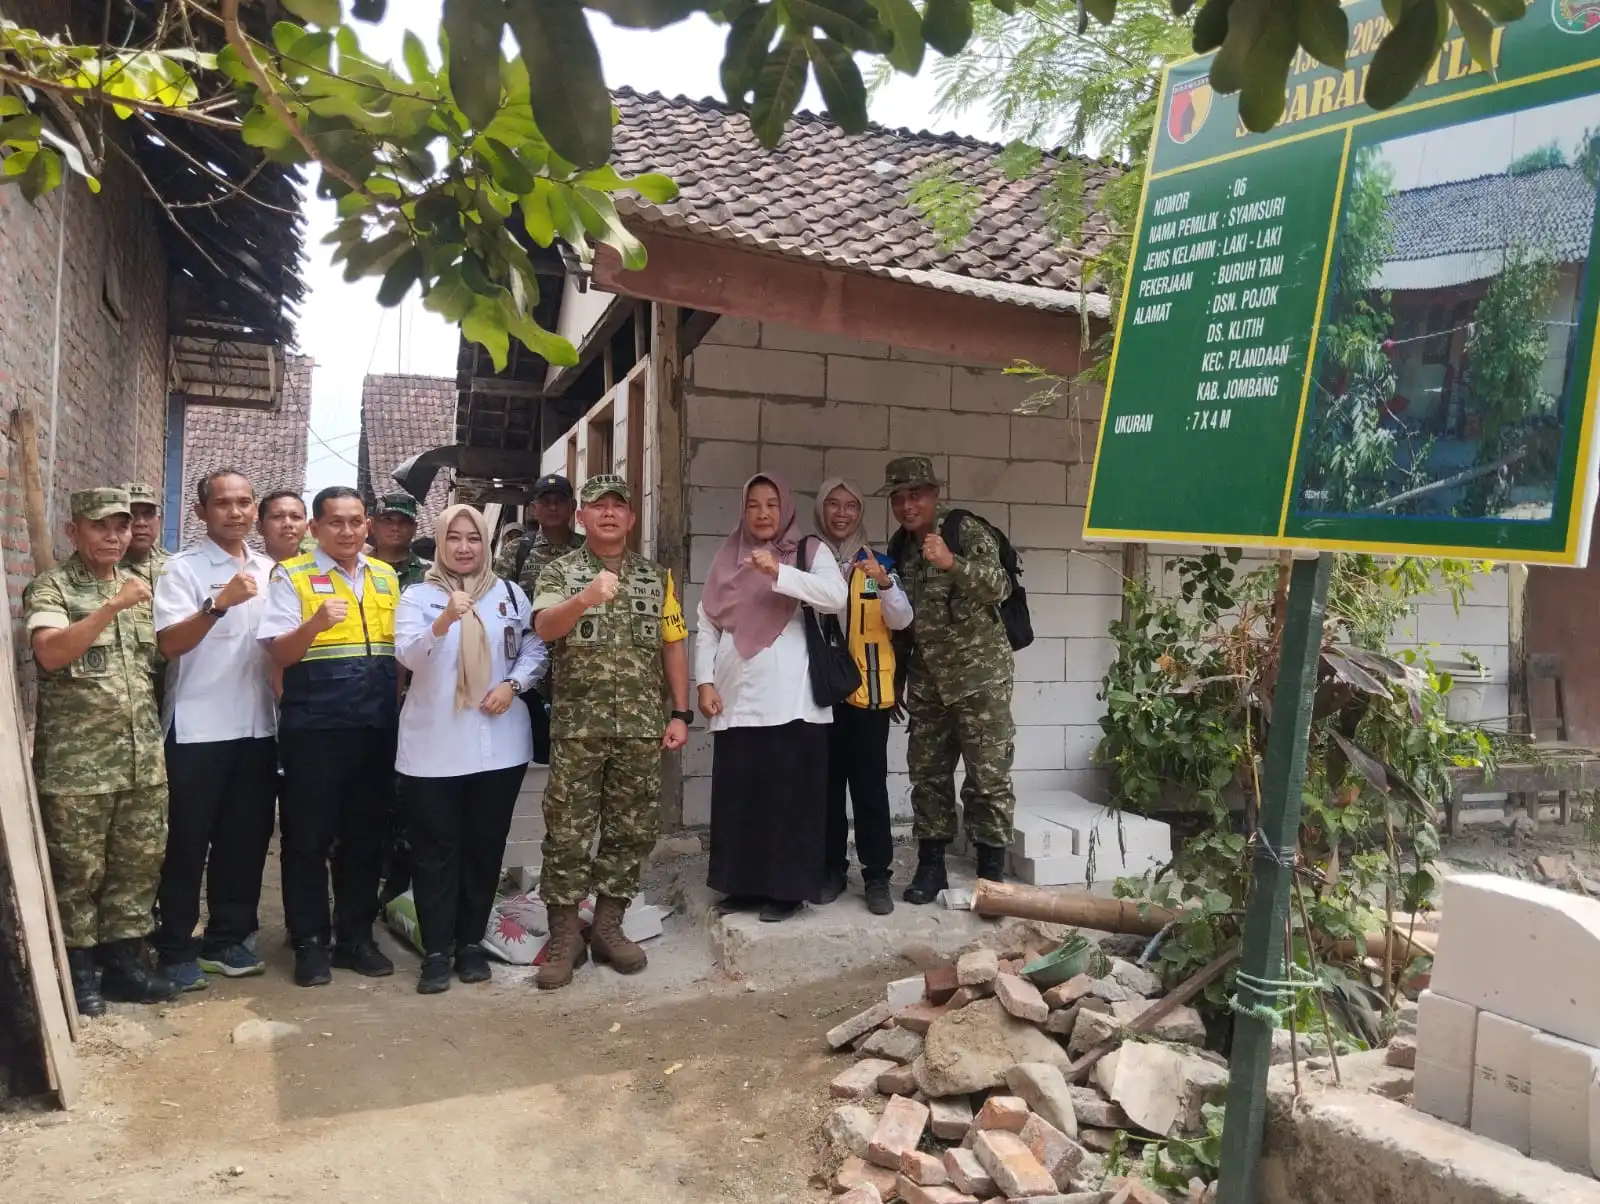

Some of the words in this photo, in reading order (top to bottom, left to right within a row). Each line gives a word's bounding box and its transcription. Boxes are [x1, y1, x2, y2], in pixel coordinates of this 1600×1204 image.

[1153, 191, 1190, 217] NOMOR
[1233, 177, 1248, 199] 06
[1148, 223, 1176, 244] NAMA
[1177, 211, 1219, 238] PEMILIK
[1228, 196, 1286, 227] SYAMSURI
[1143, 249, 1171, 272] JENIS
[1171, 239, 1217, 266] KELAMIN
[1222, 232, 1248, 256] LAKI
[1256, 225, 1283, 249] LAKI
[1138, 271, 1194, 298] PEKERJAAN
[1217, 260, 1256, 285] BURUH
[1258, 255, 1285, 278] TANI
[1133, 302, 1173, 325] ALAMAT
[1212, 292, 1238, 314] DSN.
[1241, 285, 1279, 310] POJOK
[1206, 323, 1225, 343] DS.
[1228, 317, 1265, 341] KLITIH
[1201, 351, 1225, 372] KEC.
[1228, 344, 1290, 370] PLANDAAN
[1196, 380, 1220, 401] KAB.
[1223, 375, 1280, 400] JOMBANG
[1114, 414, 1154, 434] UKURAN
[1191, 411, 1201, 430] 7
[1210, 410, 1218, 430] 4
[1219, 409, 1232, 429] M
[632, 586, 646, 595] TNI
[650, 588, 660, 597] AD
